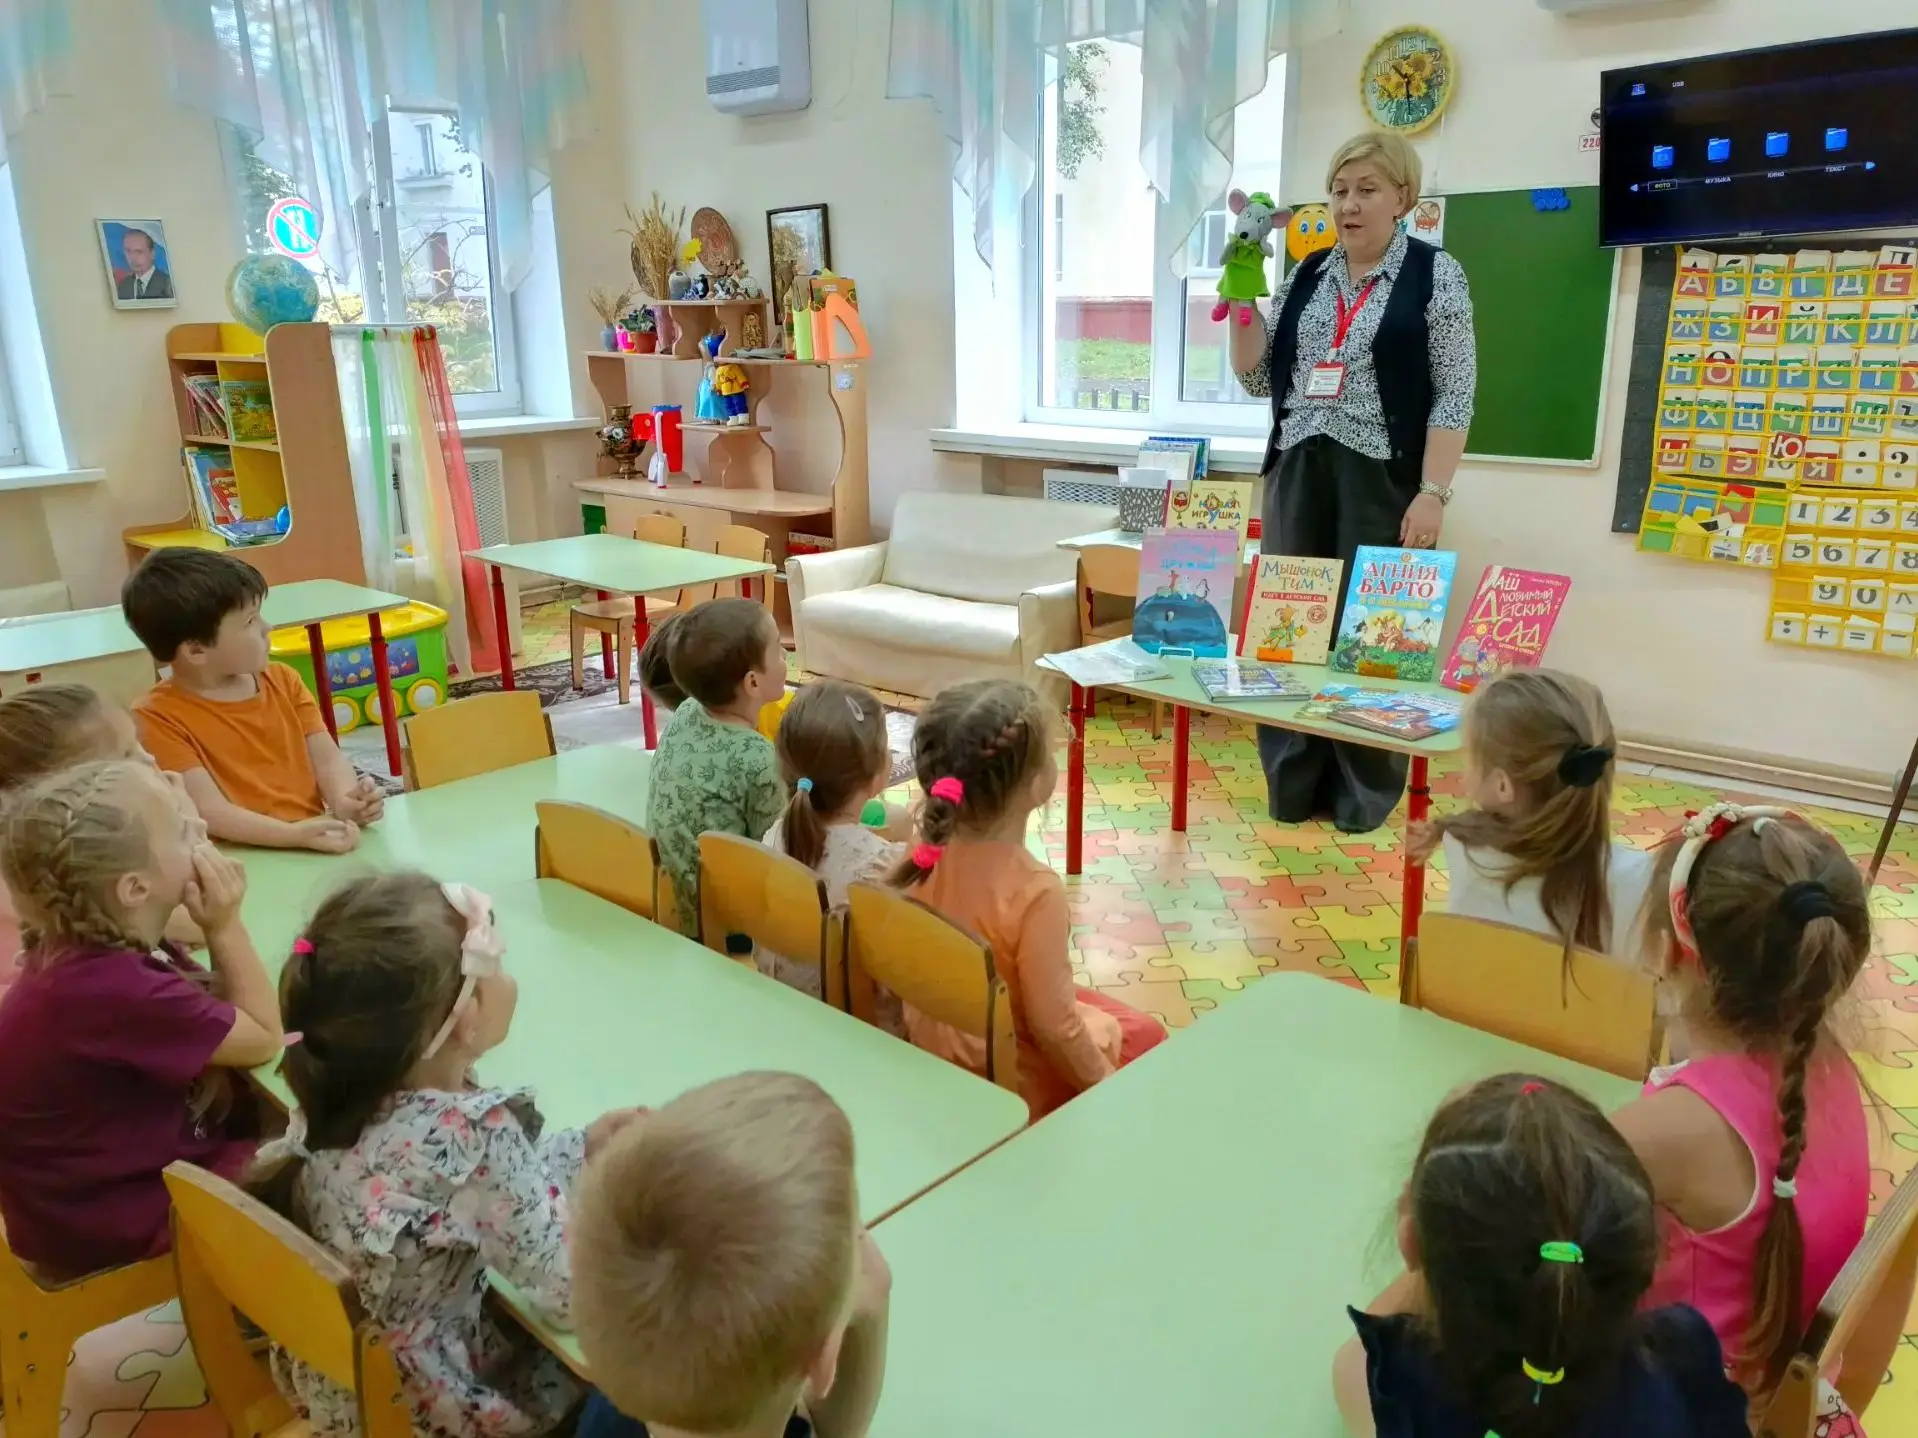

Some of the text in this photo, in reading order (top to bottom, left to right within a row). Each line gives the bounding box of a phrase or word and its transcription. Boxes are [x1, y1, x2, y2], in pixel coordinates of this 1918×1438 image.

[1388, 45, 1399, 61] 11
[1401, 37, 1416, 53] 12
[1420, 39, 1428, 54] 1
[1432, 50, 1440, 64] 2
[1377, 61, 1390, 76] 10
[1438, 68, 1446, 83] 3
[1671, 80, 1685, 88] USB
[1388, 108, 1397, 126] 7
[1404, 110, 1412, 123] 6
[1419, 103, 1428, 117] 5
[1705, 176, 1732, 184] МУЗЫКА
[1825, 165, 1847, 173] ТЕКСТ
[1680, 268, 1905, 296] А Б В Г Д Е
[1673, 313, 1701, 334] Ж
[1714, 315, 1732, 337] З
[1750, 309, 1775, 332] И
[1789, 315, 1814, 341] Й
[1832, 317, 1853, 340] К
[1870, 316, 1897, 340] Л
[1671, 359, 1693, 381] Н
[1706, 361, 1732, 383] О
[1745, 363, 1767, 384] П
[1786, 363, 1804, 384] Р
[1823, 364, 1843, 386] С
[1869, 364, 1890, 386] Т
[1664, 403, 1689, 424] Ф
[1700, 404, 1722, 426] Х
[1737, 406, 1759, 430] Ц
[1778, 407, 1798, 429] Ч
[1812, 410, 1842, 432] Ш
[1852, 405, 1884, 432] Щ
[1662, 441, 1688, 464] Ы
[1732, 450, 1753, 472] Э
[1773, 435, 1803, 460] Ю
[1806, 456, 1829, 478] Я
[1192, 510, 1241, 524] ИГРУШКА
[1796, 502, 1808, 519] 1
[1832, 502, 1852, 522] 2
[1870, 505, 1890, 525] 3
[1792, 540, 1918, 569] 5 6 7 8
[1364, 562, 1438, 581] АГНИЯ
[1360, 578, 1434, 598] БАРТО
[1499, 588, 1553, 602] ЛЮБИМЫЙ
[1818, 581, 1838, 600] 9
[1856, 587, 1877, 604] 0
[1493, 617, 1542, 649] САД
